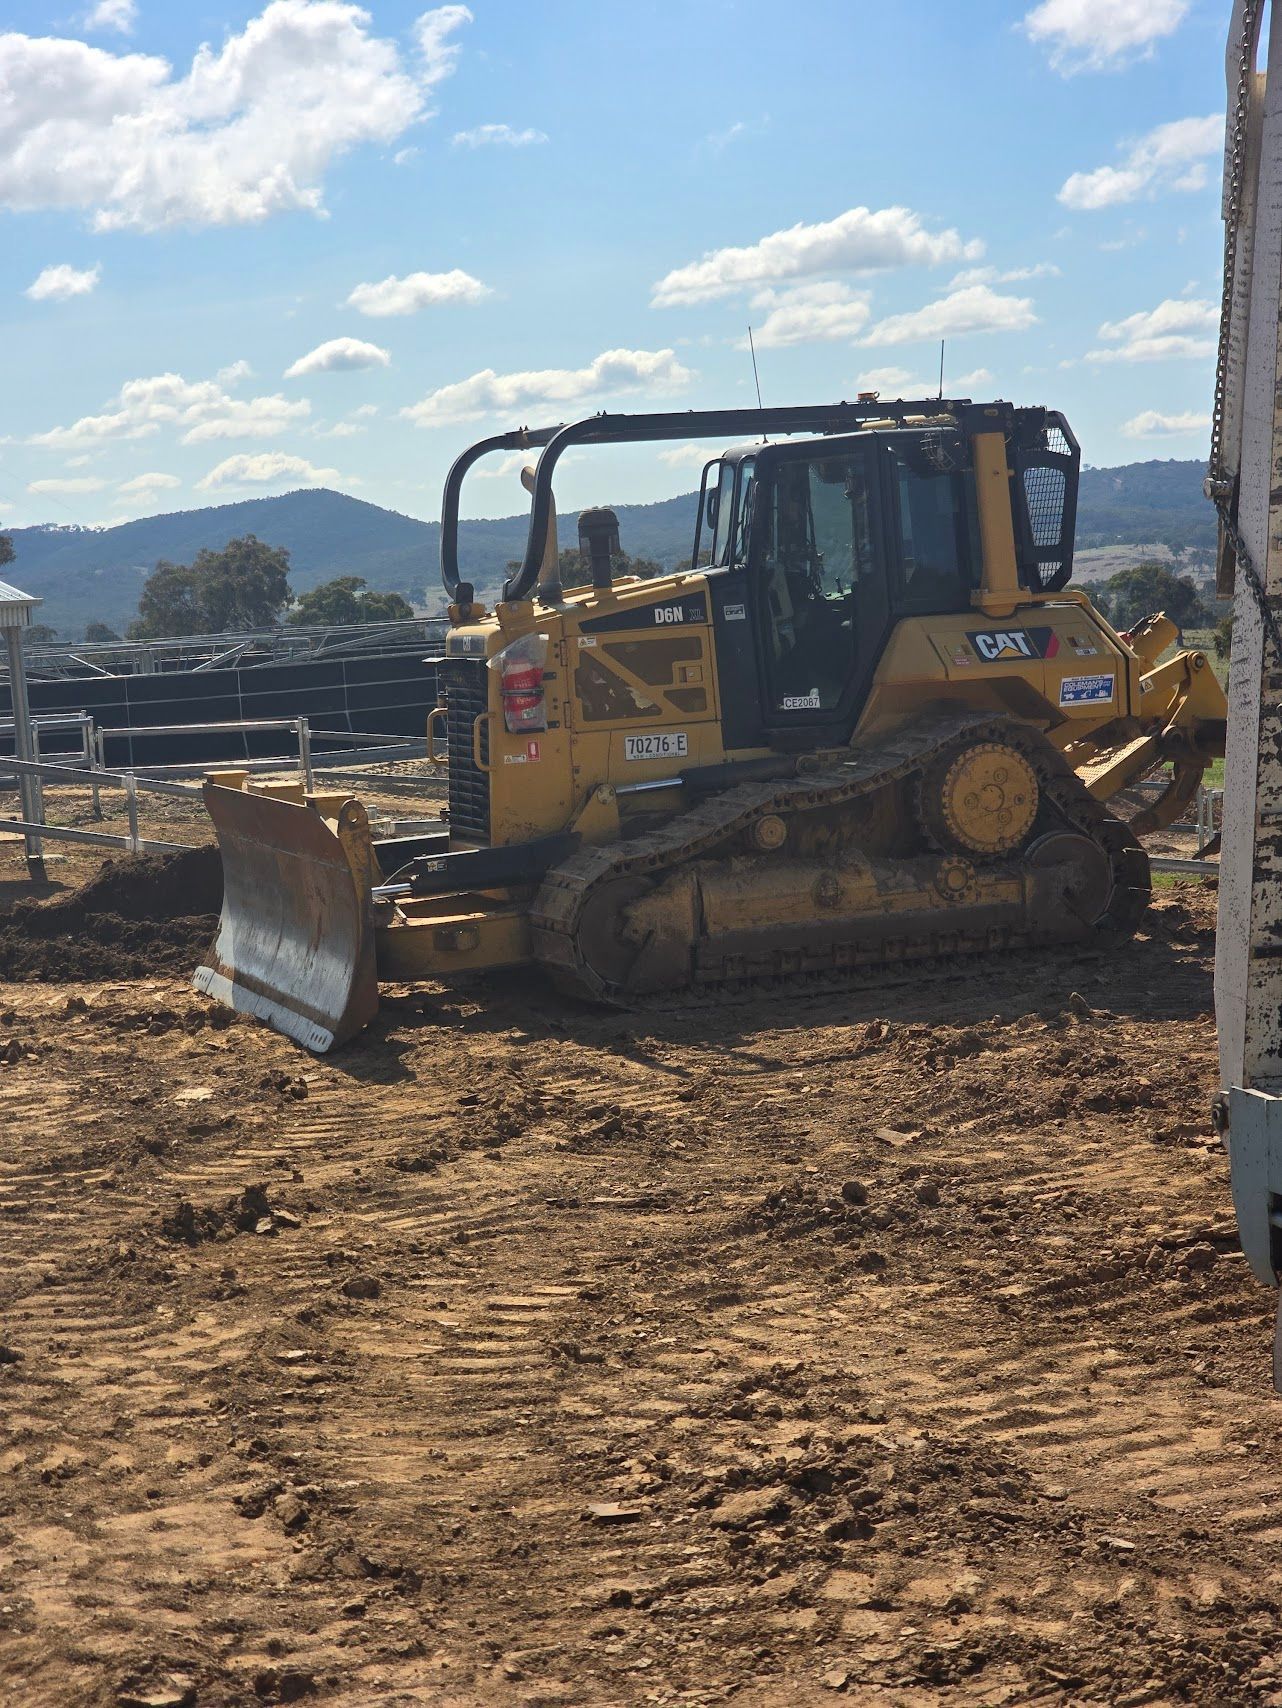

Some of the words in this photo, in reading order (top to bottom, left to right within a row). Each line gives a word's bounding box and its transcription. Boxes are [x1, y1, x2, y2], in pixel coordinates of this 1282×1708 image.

[654, 606, 684, 624] D6N
[975, 632, 1032, 659] CAT
[784, 697, 819, 708] CE2087
